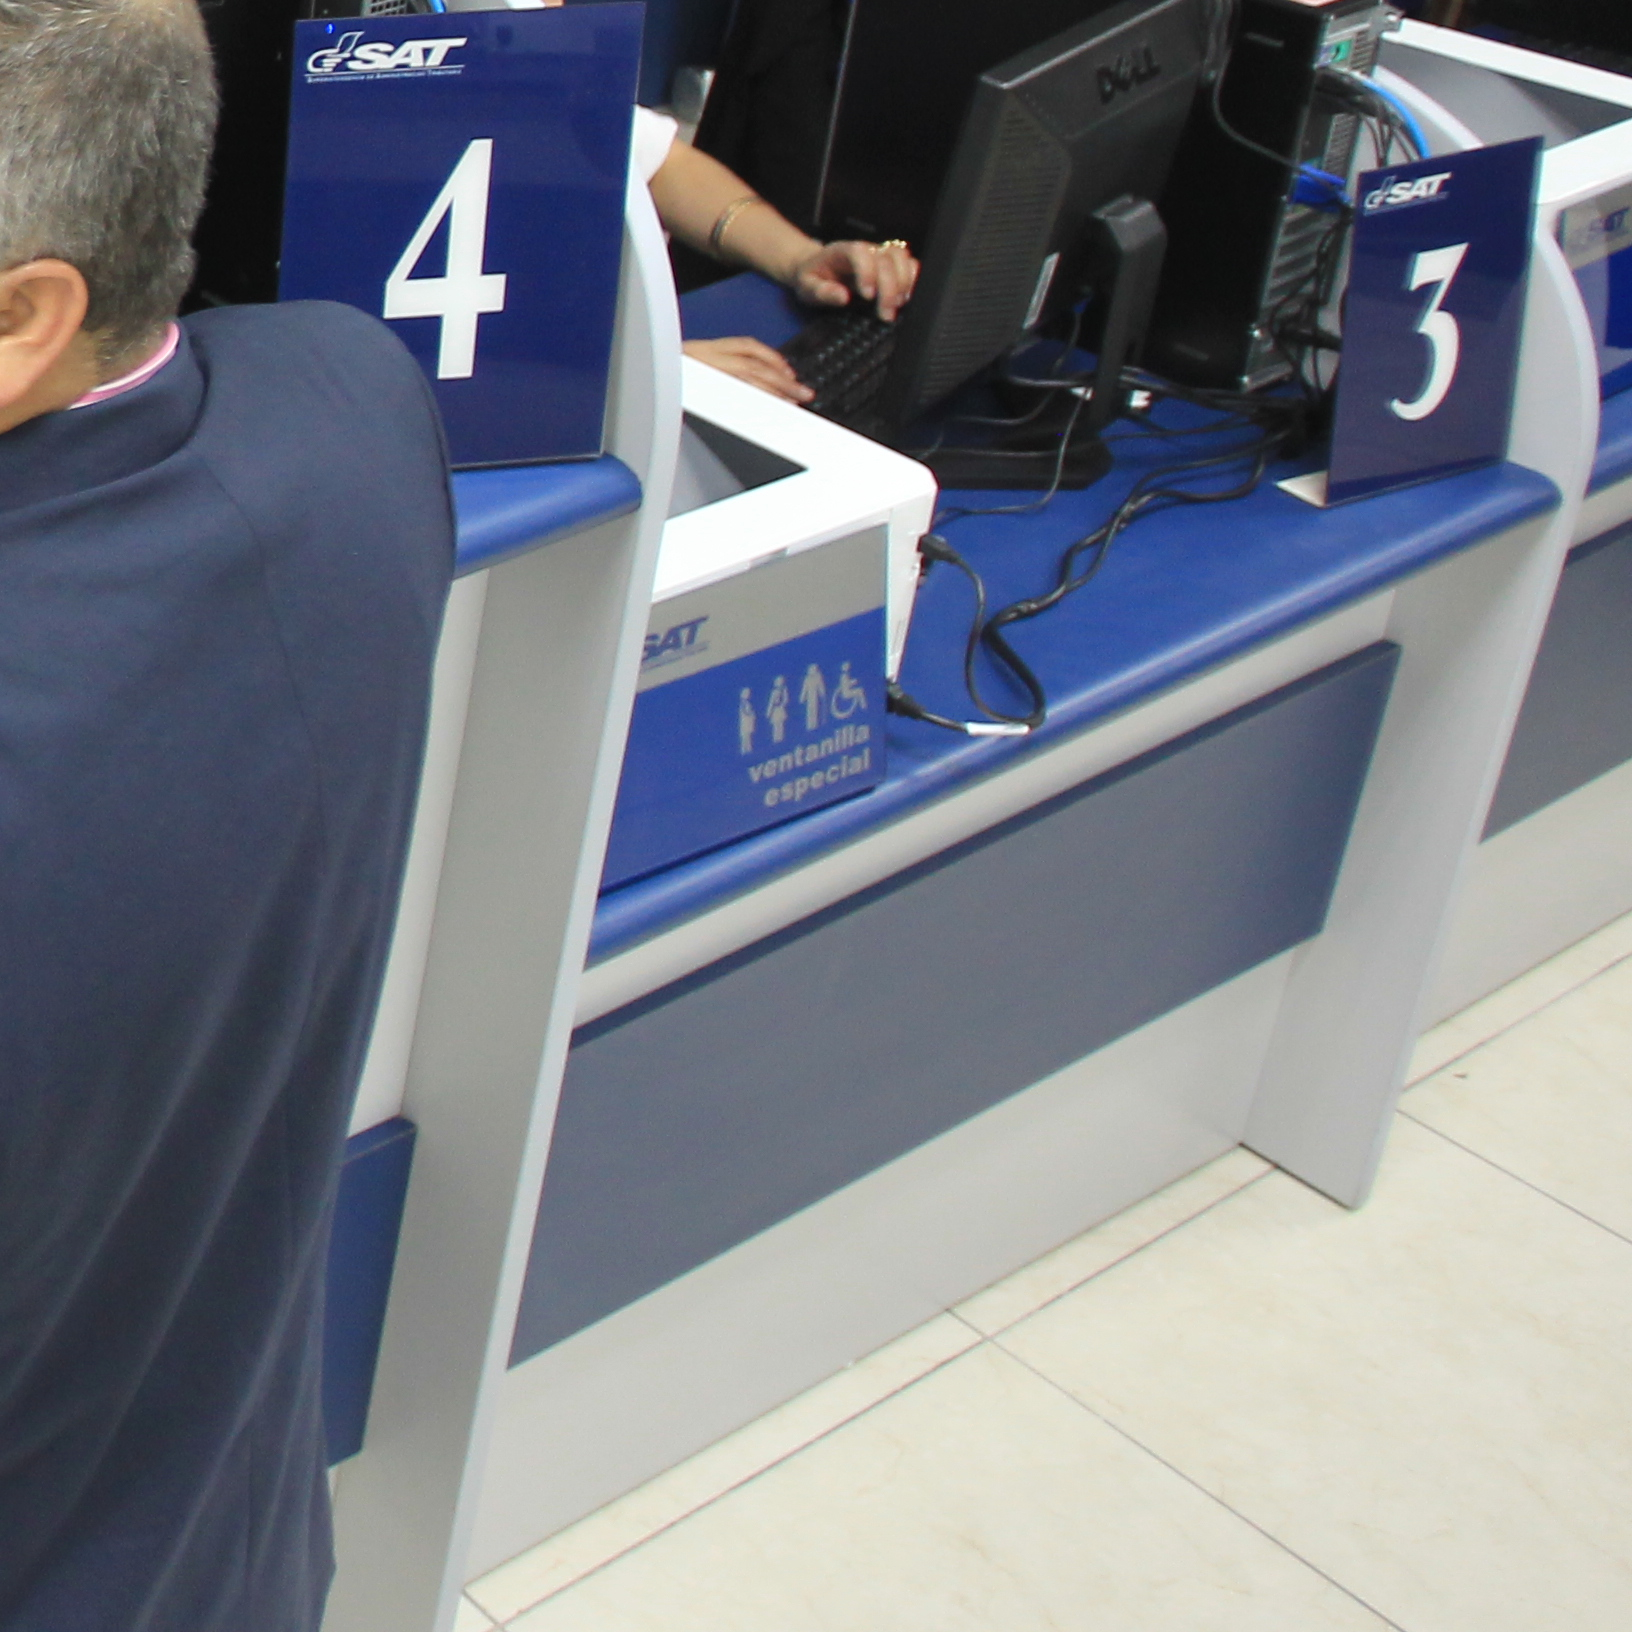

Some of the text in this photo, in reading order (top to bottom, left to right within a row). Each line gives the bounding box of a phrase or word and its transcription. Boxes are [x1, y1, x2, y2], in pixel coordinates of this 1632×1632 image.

[346, 37, 468, 71] SAT
[1385, 172, 1452, 205] SAT
[382, 137, 507, 380] 4
[1390, 242, 1469, 421] 3
[641, 615, 709, 665] SAT
[748, 724, 871, 783] ventanilla
[764, 747, 871, 807] especial
